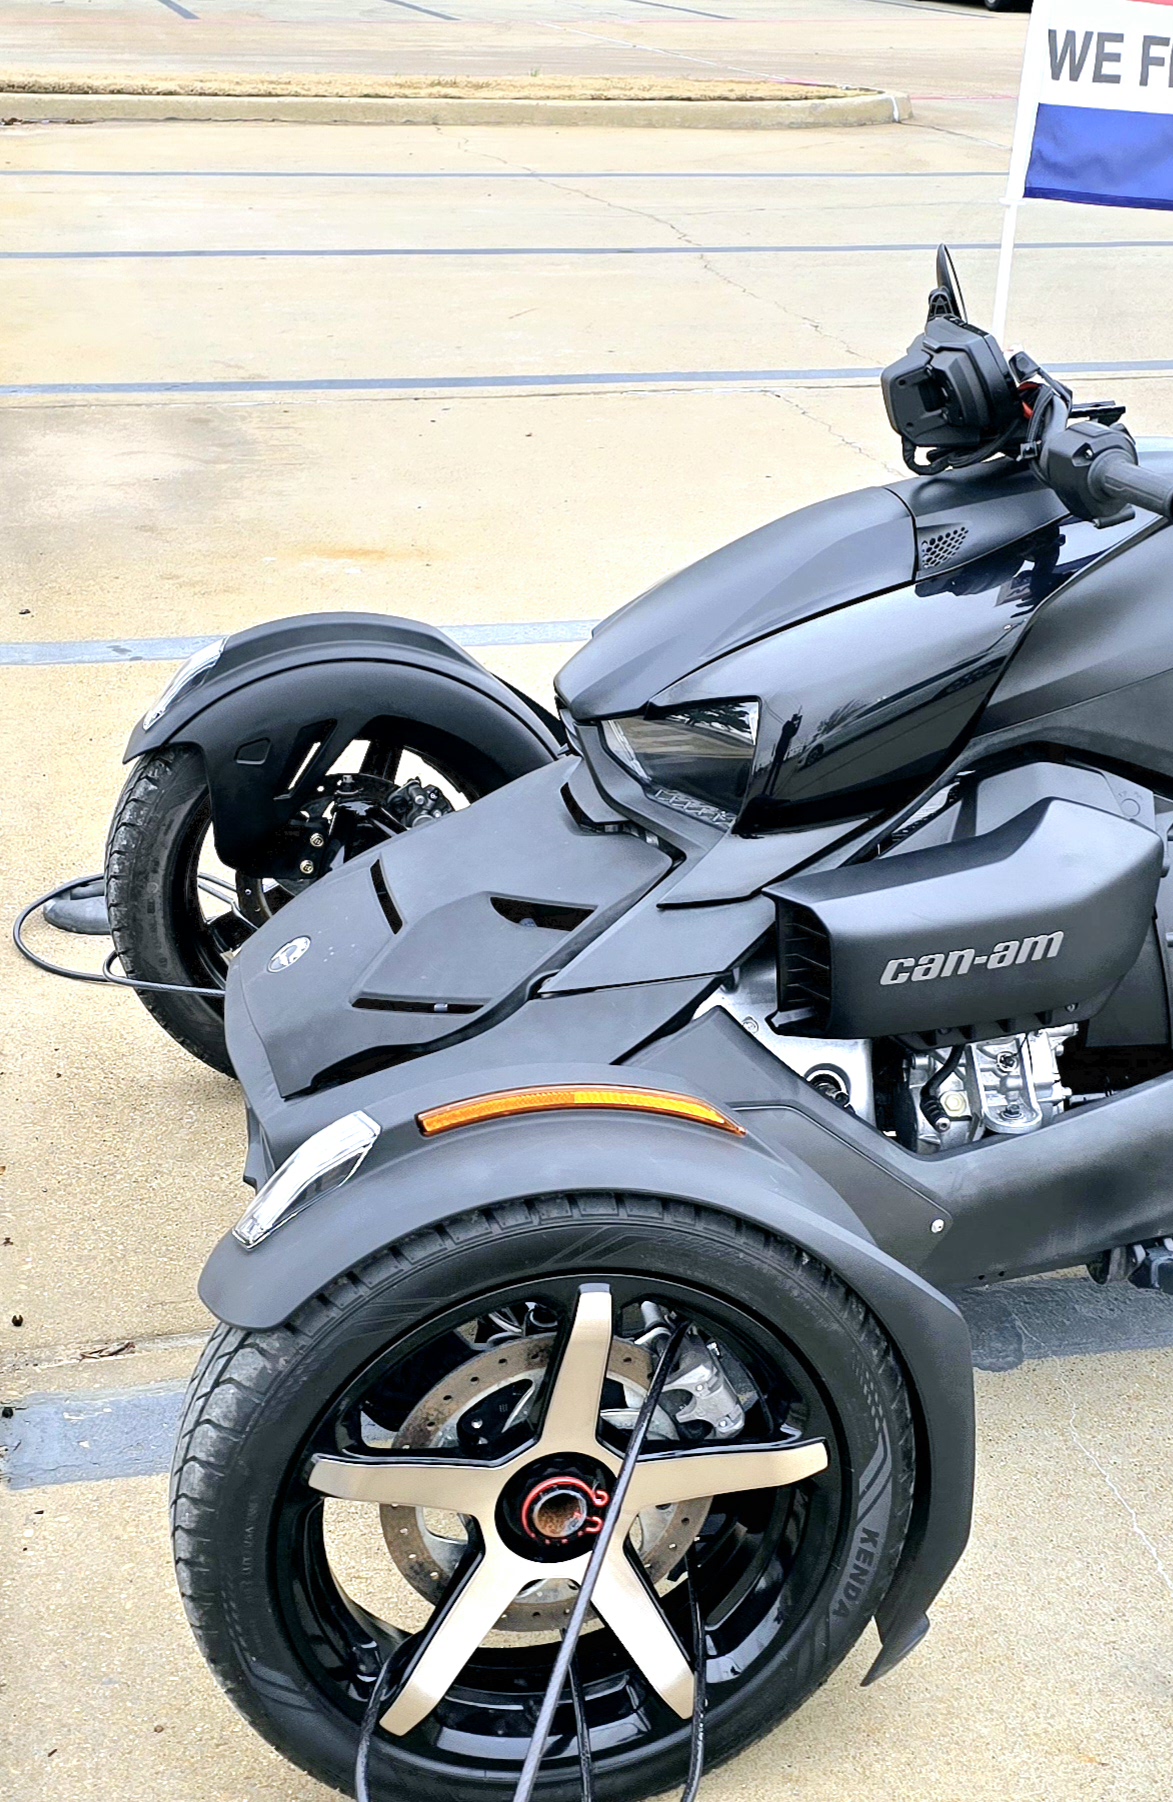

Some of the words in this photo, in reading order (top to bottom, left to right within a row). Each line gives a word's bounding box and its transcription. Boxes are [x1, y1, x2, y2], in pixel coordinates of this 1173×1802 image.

[1048, 28, 1124, 84] WE
[880, 930, 1064, 985] can-am
[832, 1526, 880, 1618] KENDA
